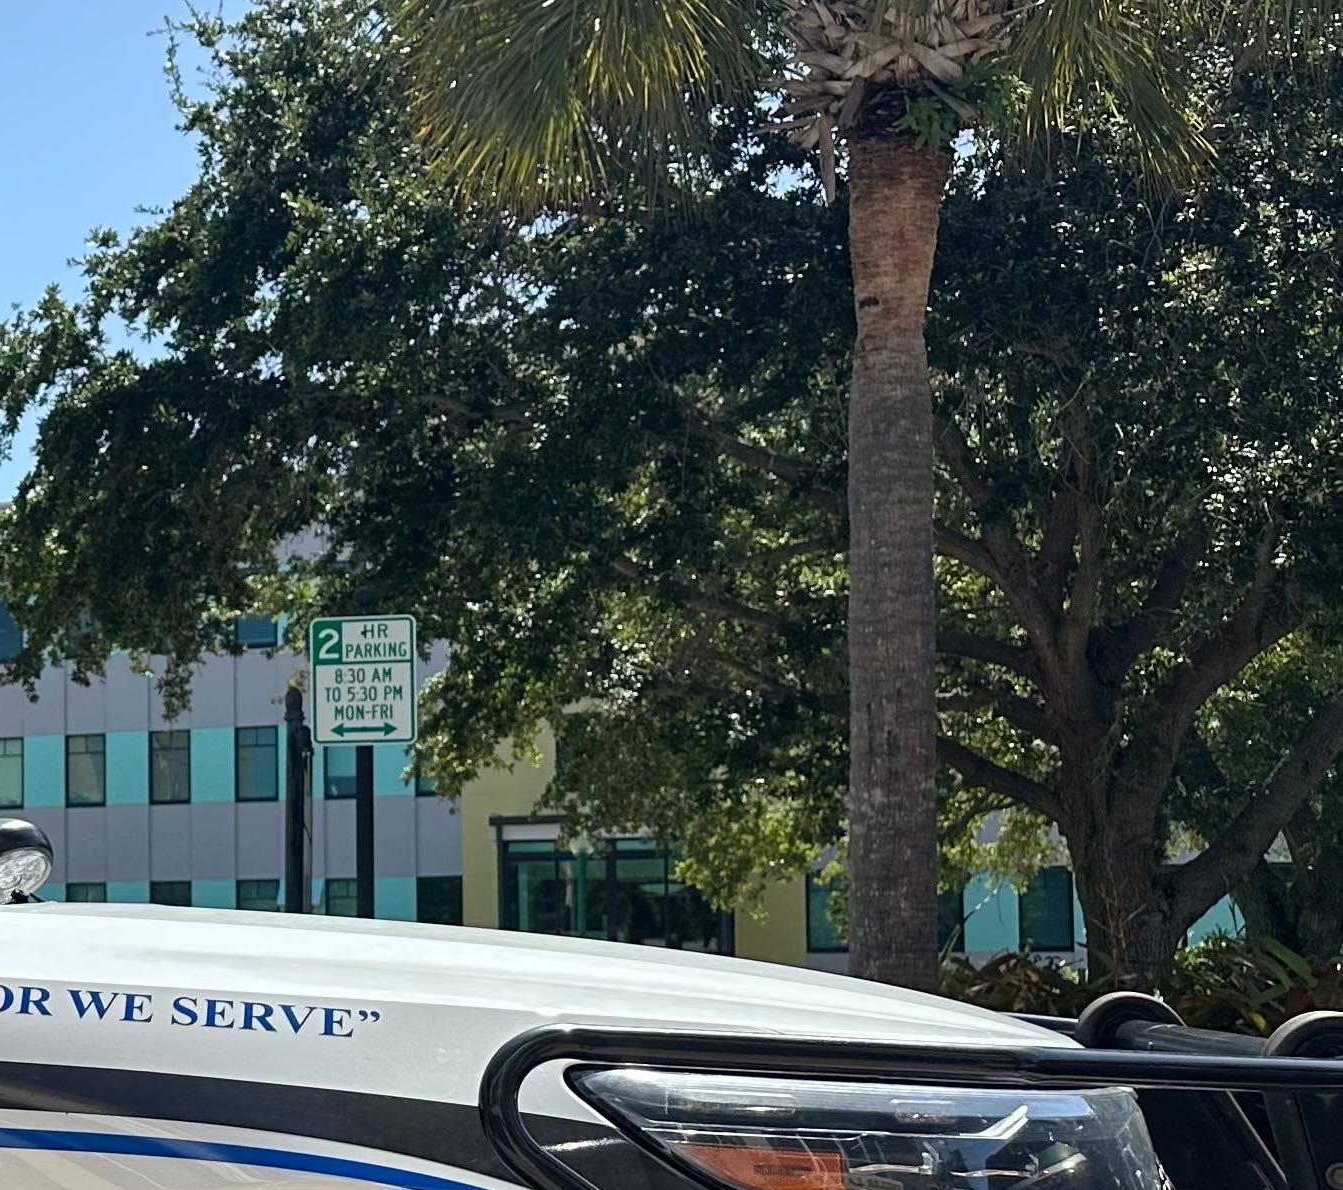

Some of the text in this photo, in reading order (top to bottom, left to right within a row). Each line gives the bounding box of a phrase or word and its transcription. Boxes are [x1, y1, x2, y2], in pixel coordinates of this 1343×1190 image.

[318, 623, 388, 659] 2 HR
[345, 642, 407, 659] PARKING
[334, 667, 393, 684] 8:30 AM
[324, 685, 404, 702] TO 5:30 PM
[334, 704, 393, 720] MON-FRI
[66, 989, 153, 1023] WE
